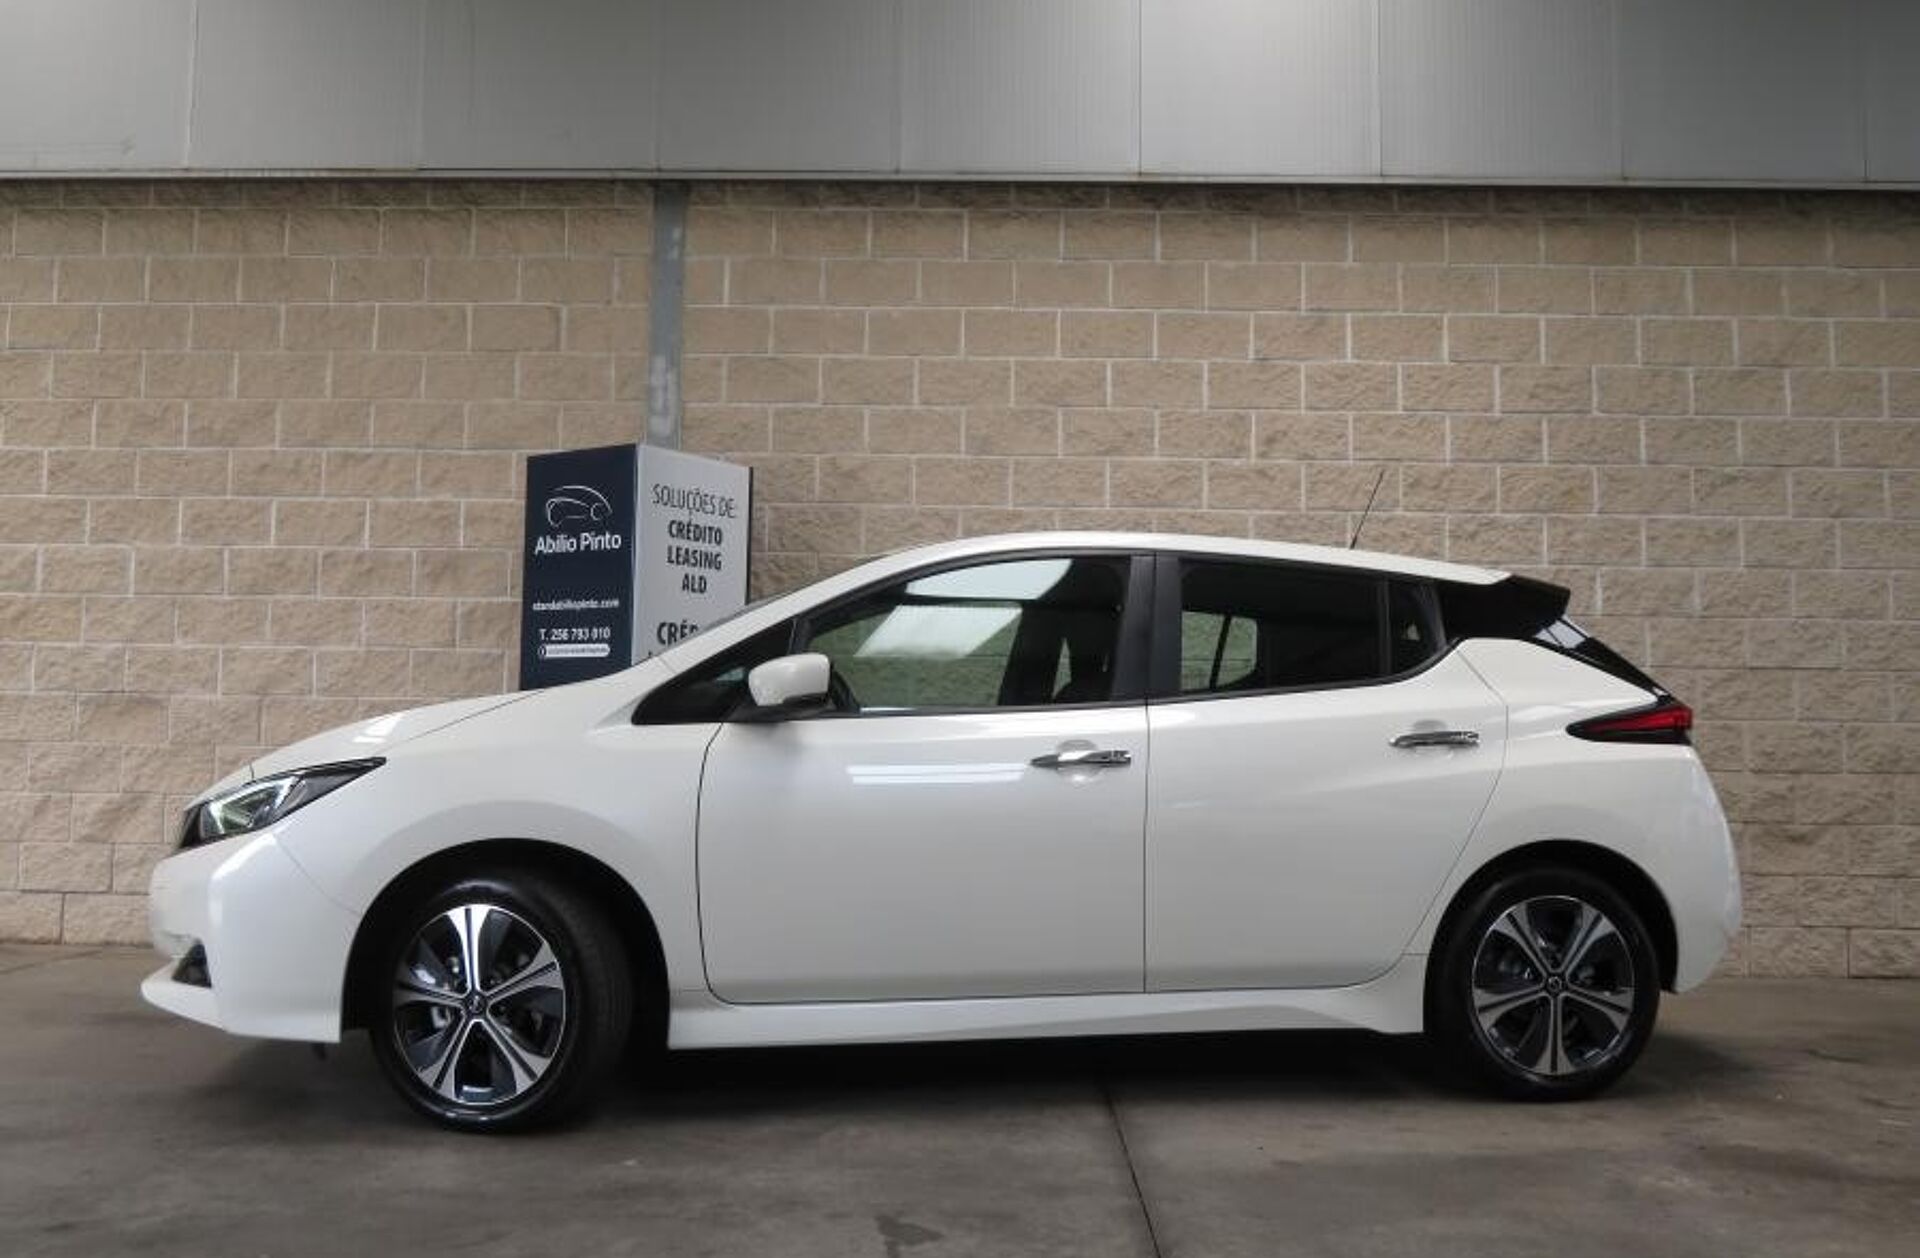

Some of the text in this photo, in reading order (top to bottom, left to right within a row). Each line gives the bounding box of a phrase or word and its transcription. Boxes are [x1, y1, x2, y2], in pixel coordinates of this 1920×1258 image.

[652, 483, 716, 515] SOLUÇÕES
[580, 531, 621, 551] Pinto
[667, 519, 723, 545] CRÉDITO
[667, 546, 722, 571] LEASING
[682, 573, 707, 594] ALD
[539, 628, 549, 640] T.
[551, 628, 569, 641] 256
